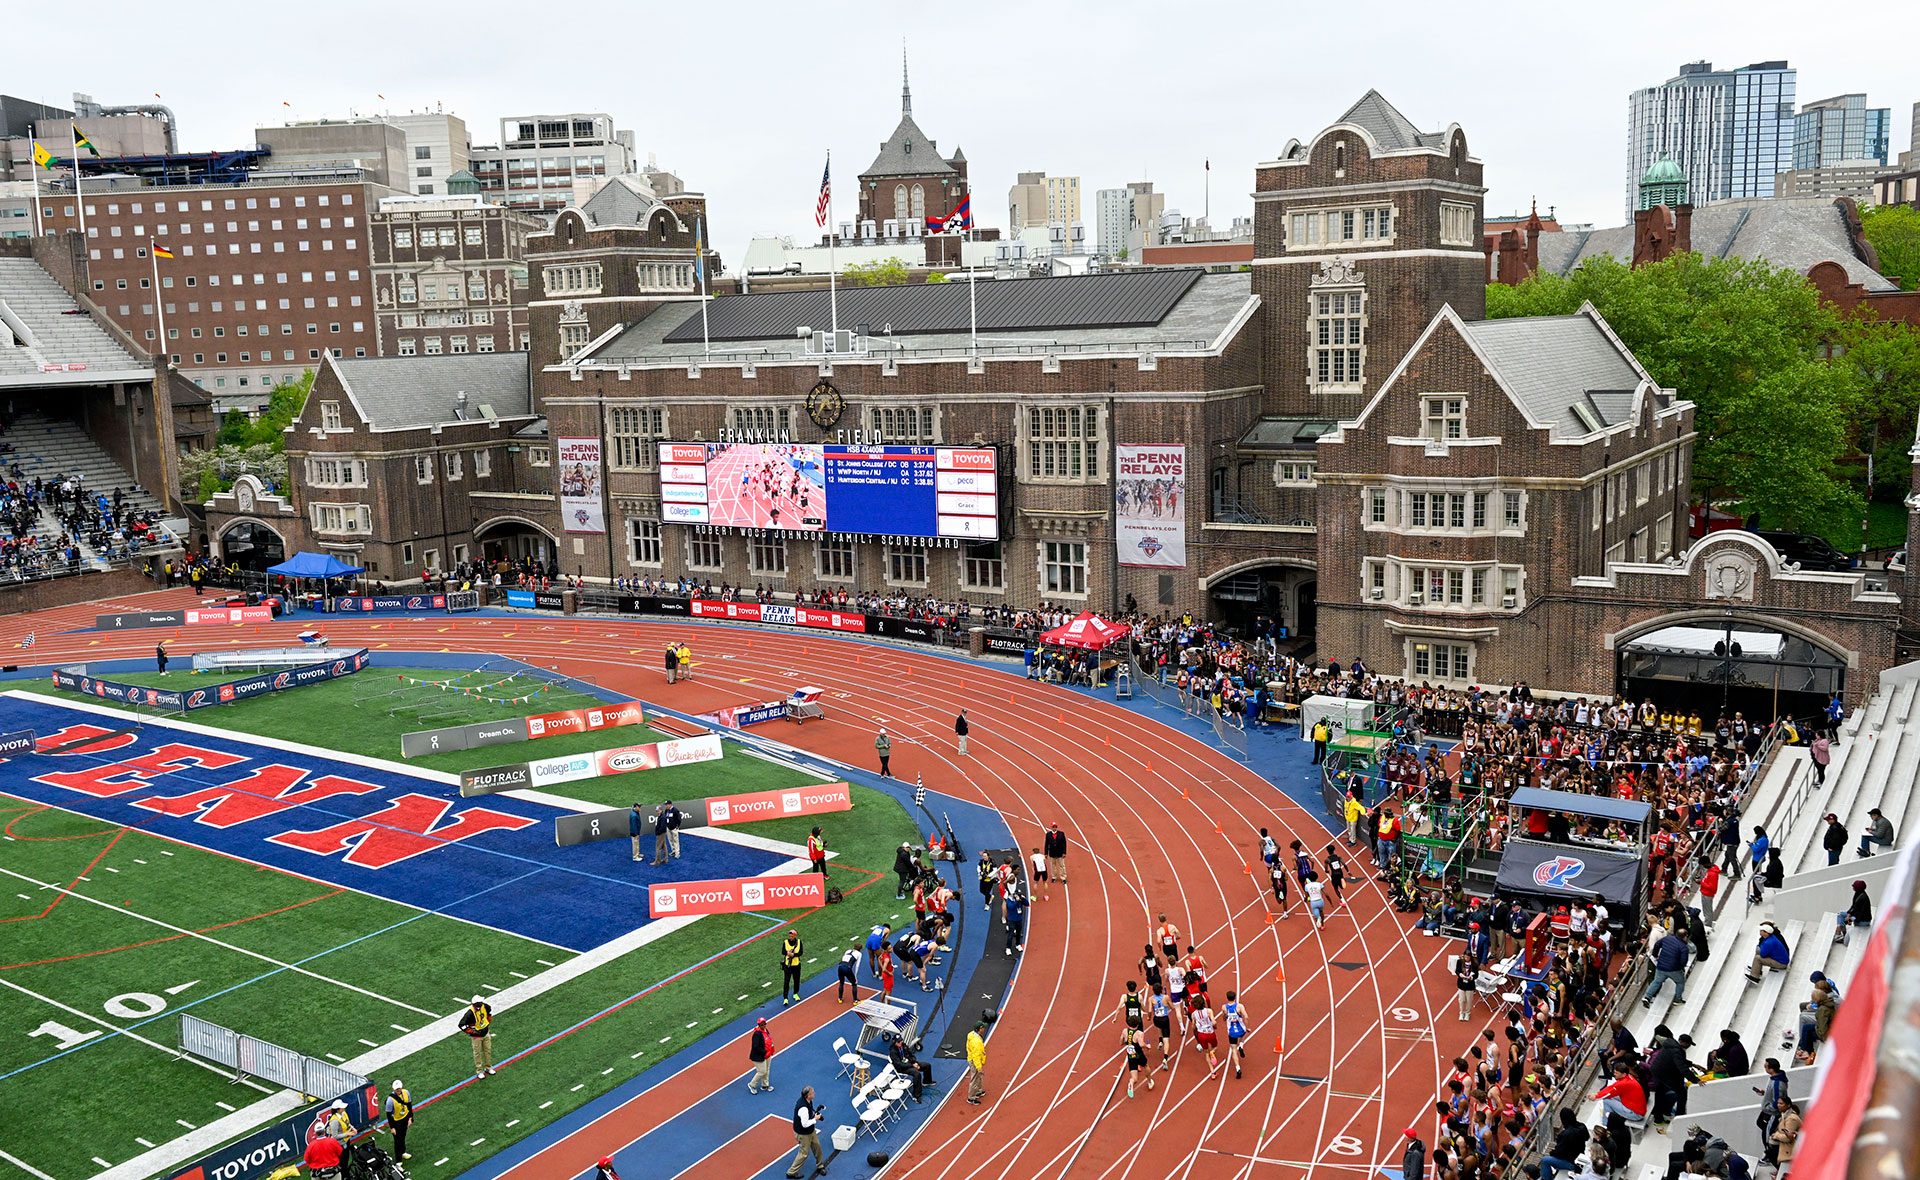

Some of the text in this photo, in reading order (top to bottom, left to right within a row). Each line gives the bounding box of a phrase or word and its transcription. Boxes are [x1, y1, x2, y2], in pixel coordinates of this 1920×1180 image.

[718, 428, 882, 444] FRANKLIN FIELD
[571, 444, 599, 452] PENN
[674, 449, 702, 458] TOYOTA
[562, 454, 600, 462] RELAYS
[954, 454, 991, 464] TOYOTA
[1137, 454, 1182, 464] PENN
[1120, 464, 1182, 475] RELAYS
[696, 526, 732, 536] ROBERT
[774, 530, 824, 542] JOHNSON
[832, 532, 872, 544] FAMILY
[882, 536, 959, 549] SCOREBOARD
[738, 608, 759, 616] TOYOTA
[766, 606, 790, 614] PENN
[762, 613, 796, 624] RELAYS
[808, 614, 828, 622] TOYOTA
[842, 618, 863, 626] TOYOTA
[990, 640, 1025, 649] FLOTRACK
[296, 668, 326, 680] TOYOTA
[59, 676, 75, 686] TOYOTA
[104, 686, 124, 696] TOYOTA
[236, 682, 267, 694] TOYOTA
[604, 709, 639, 721] TOYOTA
[749, 710, 768, 722] PENN
[547, 717, 582, 729] TOYOTA
[478, 728, 515, 739] Dream On.
[614, 757, 642, 766] Grace
[536, 764, 570, 776] College
[474, 770, 526, 786] FLOTRACK
[804, 792, 846, 806] TOYOTA
[732, 801, 776, 814] TOYOTA
[768, 885, 820, 898] TOYOTA
[681, 891, 732, 904] TOYOTA
[1330, 1136, 1363, 1156] 8
[212, 1138, 290, 1180] TOYOTA
